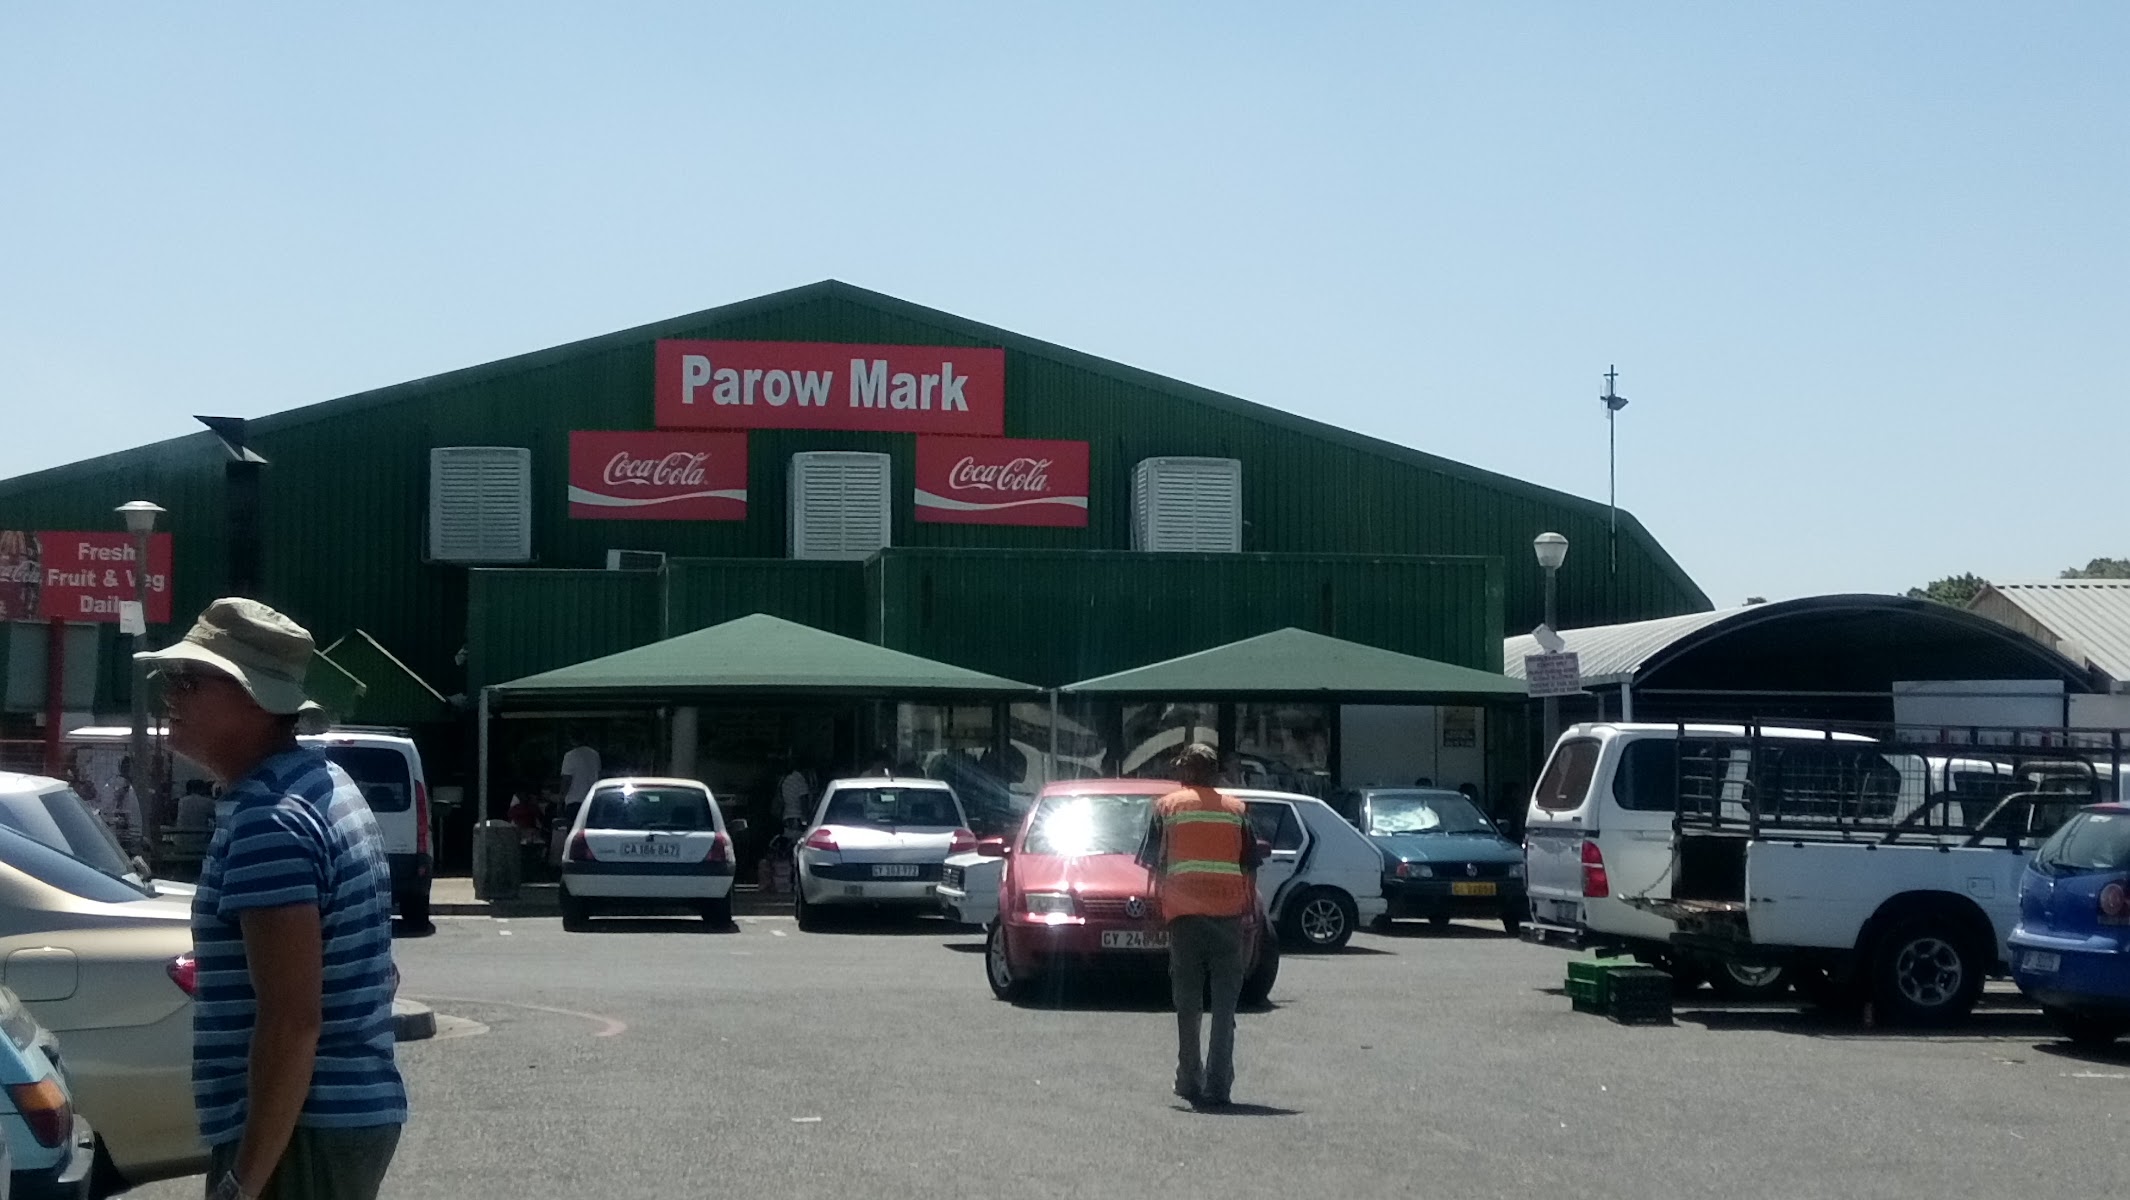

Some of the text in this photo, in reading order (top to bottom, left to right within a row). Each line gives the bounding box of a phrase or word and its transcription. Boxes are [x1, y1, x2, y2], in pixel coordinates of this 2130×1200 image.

[682, 355, 969, 412] Parow Mark
[603, 451, 712, 486] Coca-Cola
[949, 456, 1053, 491] Coca-Cola
[78, 542, 136, 561] Fresh
[47, 568, 97, 588] Fruit
[102, 569, 119, 588] &
[80, 595, 121, 613] Dail
[1103, 932, 1119, 946] CY
